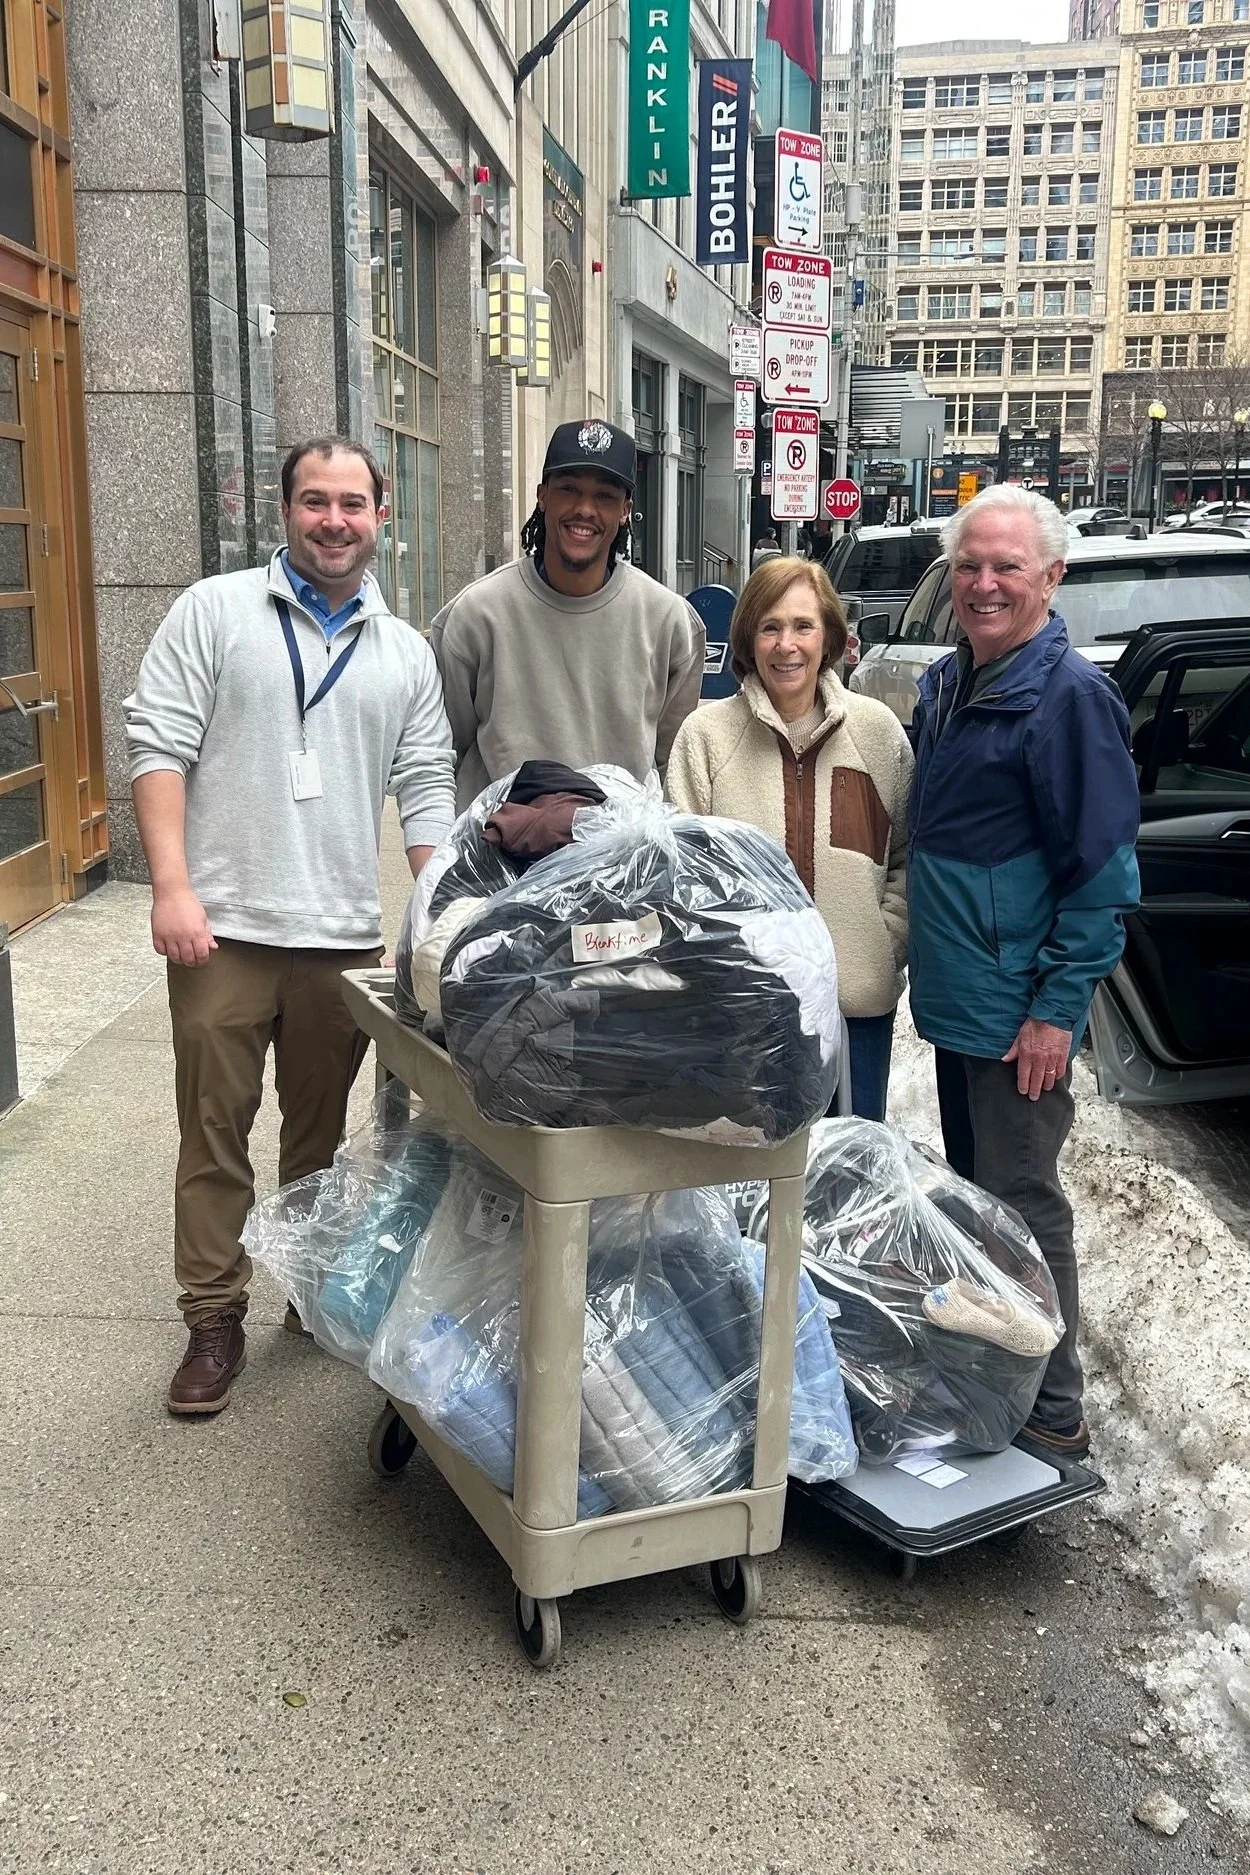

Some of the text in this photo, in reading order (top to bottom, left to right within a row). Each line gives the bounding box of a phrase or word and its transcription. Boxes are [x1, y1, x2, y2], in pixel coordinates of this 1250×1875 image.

[780, 136, 821, 158] TOW ZONE
[709, 100, 738, 253] BOHLER
[790, 213, 810, 224] Parking
[772, 255, 825, 274] TOW ZONE
[788, 275, 816, 290] LOADING
[805, 304, 817, 312] LIMIT
[780, 311, 796, 320] EXCEPT
[797, 313, 806, 321] SAT
[790, 338, 814, 351] PICKUP
[785, 353, 818, 367] DROP-OFF
[777, 415, 816, 431] TOW ZONE
[827, 491, 858, 507] STOP
[585, 932, 648, 951] Breaktime
